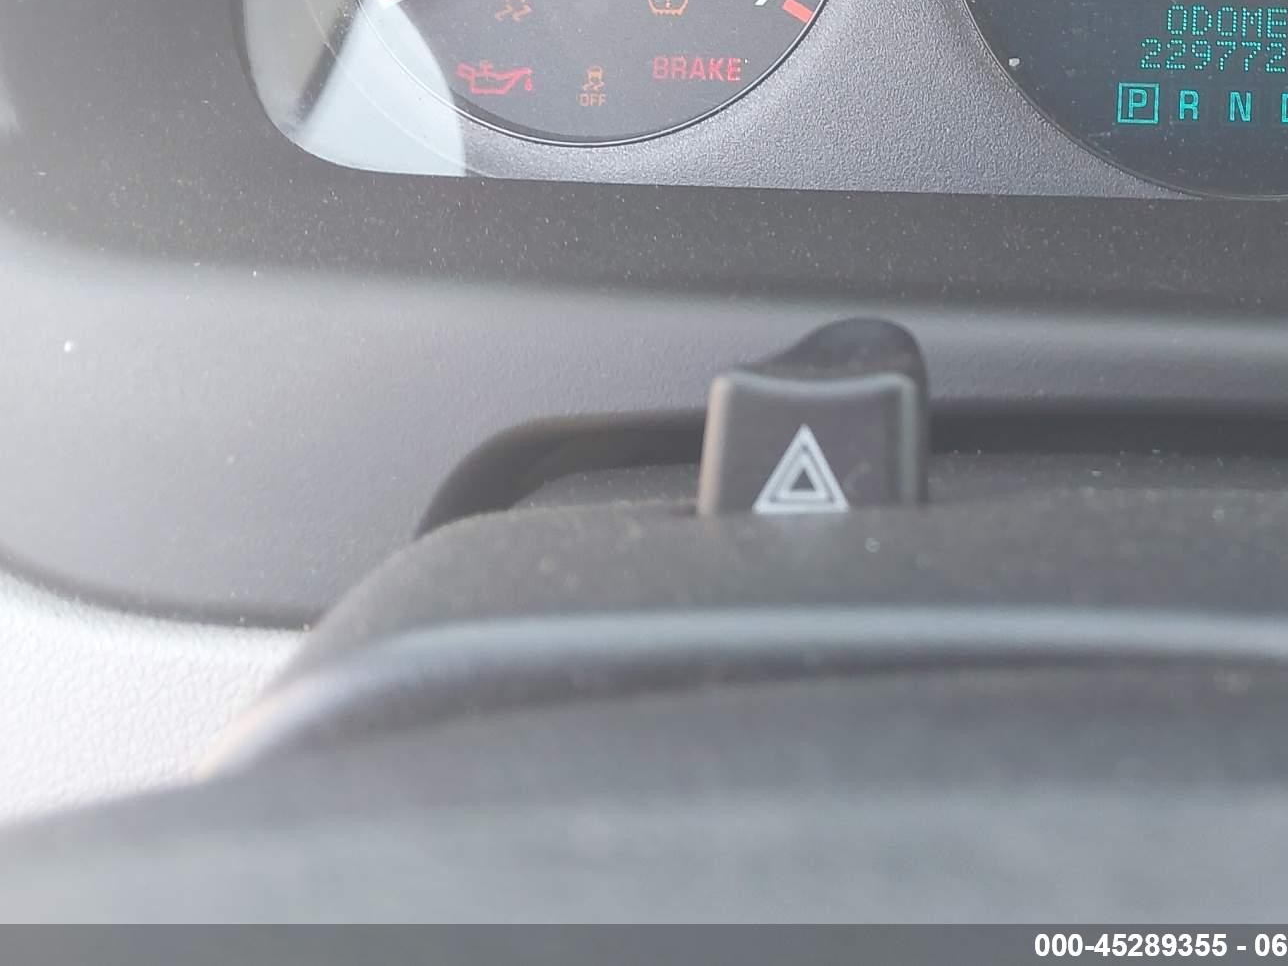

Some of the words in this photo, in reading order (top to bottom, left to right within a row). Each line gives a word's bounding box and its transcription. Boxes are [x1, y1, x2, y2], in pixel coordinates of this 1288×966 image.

[652, 57, 743, 83] BRAKE
[1140, 38, 1287, 73] 229772
[579, 94, 606, 107] OFF
[1127, 89, 1148, 117] P
[1179, 91, 1199, 121] R
[1230, 92, 1251, 122] N
